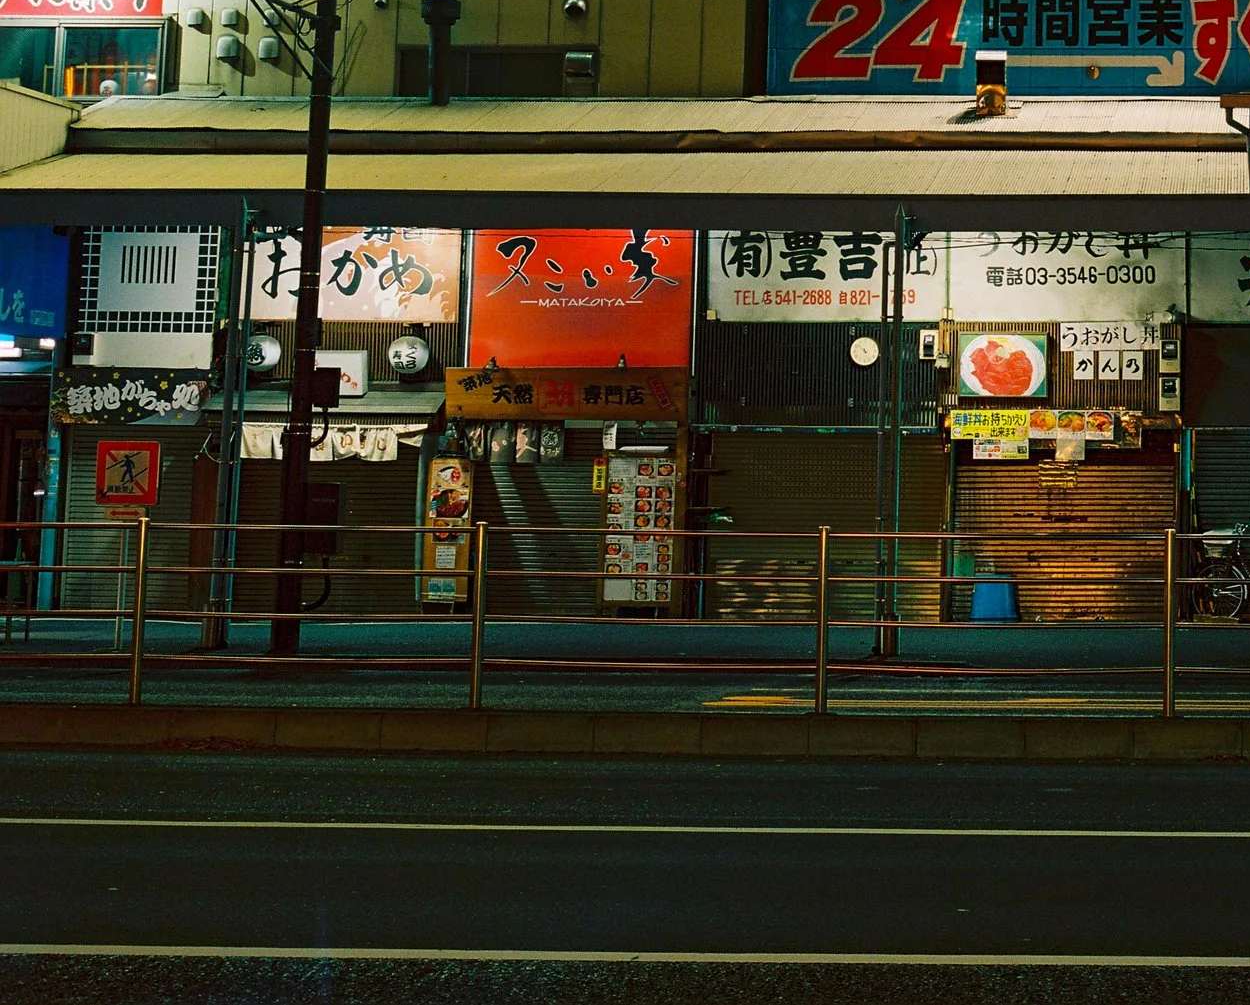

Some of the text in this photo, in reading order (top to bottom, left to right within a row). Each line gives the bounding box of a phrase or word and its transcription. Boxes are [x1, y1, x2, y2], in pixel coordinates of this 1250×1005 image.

[538, 297, 626, 308] MATAKOIYA
[1061, 326, 1160, 348] うおがし丼
[66, 379, 201, 415] 築地がちゃ処
